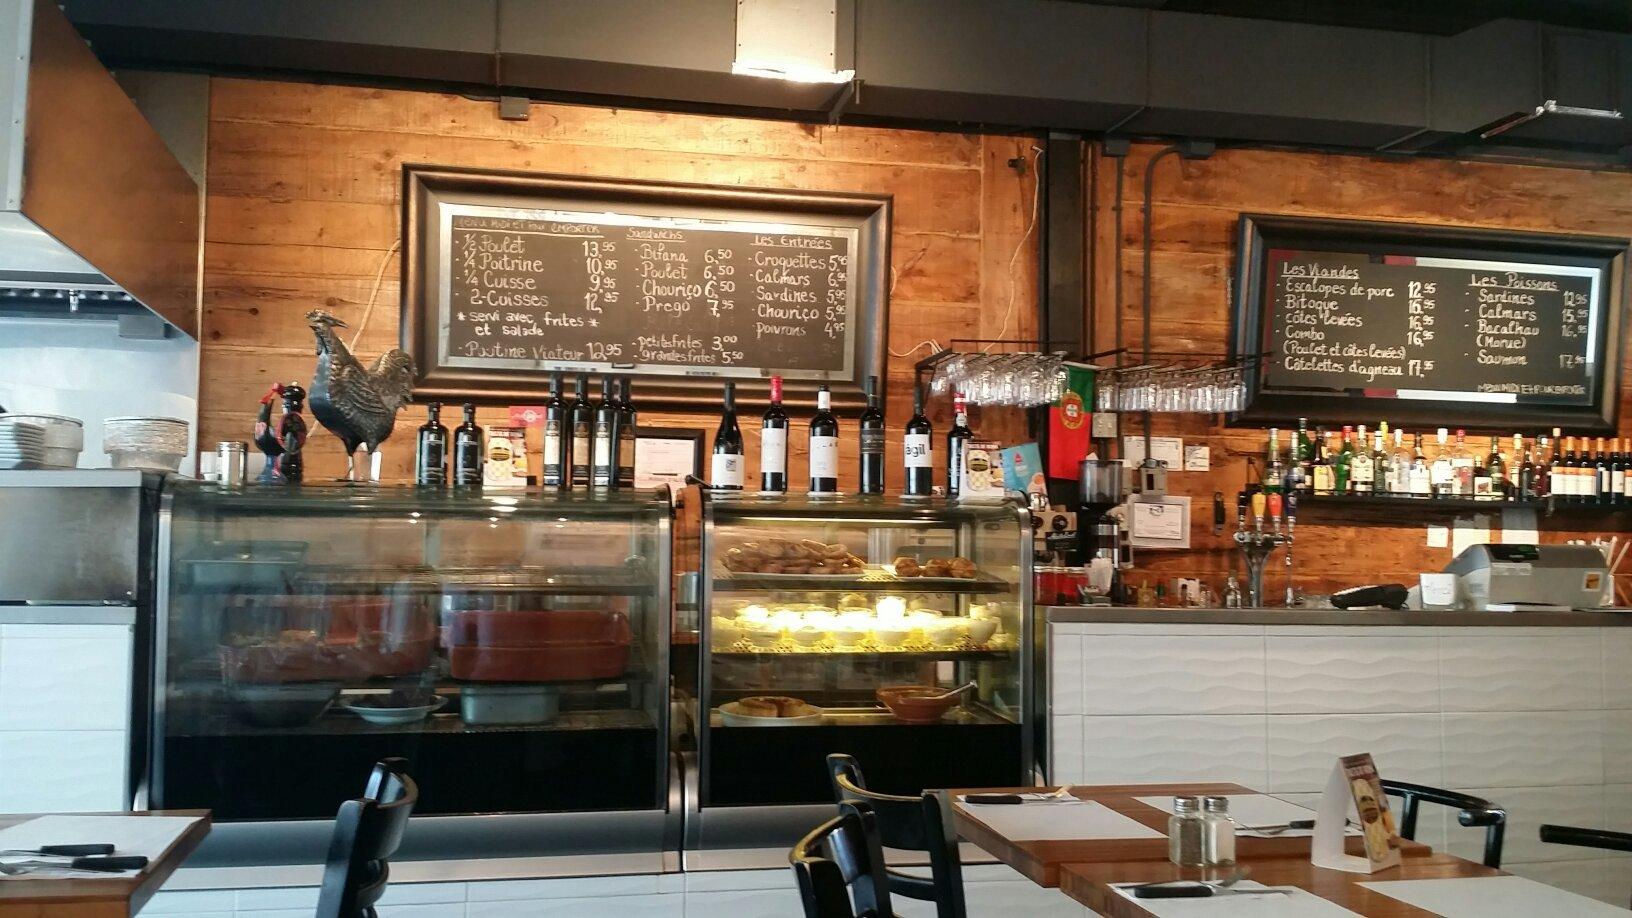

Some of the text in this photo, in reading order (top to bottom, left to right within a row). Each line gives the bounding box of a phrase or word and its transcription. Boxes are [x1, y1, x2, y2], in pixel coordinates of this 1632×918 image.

[479, 234, 526, 254] Poulet
[754, 235, 832, 249] Les Entrées
[640, 243, 688, 262] Bifana
[479, 253, 544, 273] Poitrine
[641, 260, 688, 279] Poulet
[755, 251, 827, 275] Croquettes
[1283, 262, 1359, 279] Les Viandes
[484, 270, 537, 290] Cuisse
[755, 268, 810, 286] Calmars
[1471, 271, 1557, 290] Les Poissons
[642, 279, 702, 300] Chouriço
[757, 286, 817, 303] Sardines
[1286, 276, 1347, 298] Escalopes
[1350, 281, 1366, 296] de
[1367, 287, 1395, 300] porc
[1478, 288, 1535, 306] Sardines
[642, 295, 691, 317] Prego
[1285, 293, 1339, 312] Bitoque
[469, 310, 584, 328] servi avec frites
[758, 303, 819, 322] Chouriço
[1324, 310, 1363, 327] levées
[1478, 303, 1538, 321] Calmars
[475, 323, 545, 337] et salade
[1285, 325, 1325, 341] Combo
[1476, 318, 1540, 336] Bacalhau
[1283, 340, 1328, 356] (Poulet
[1329, 341, 1342, 356] et
[1475, 334, 1528, 349] (Morue)
[532, 344, 584, 361] Viateur
[1476, 349, 1529, 365] Saumon
